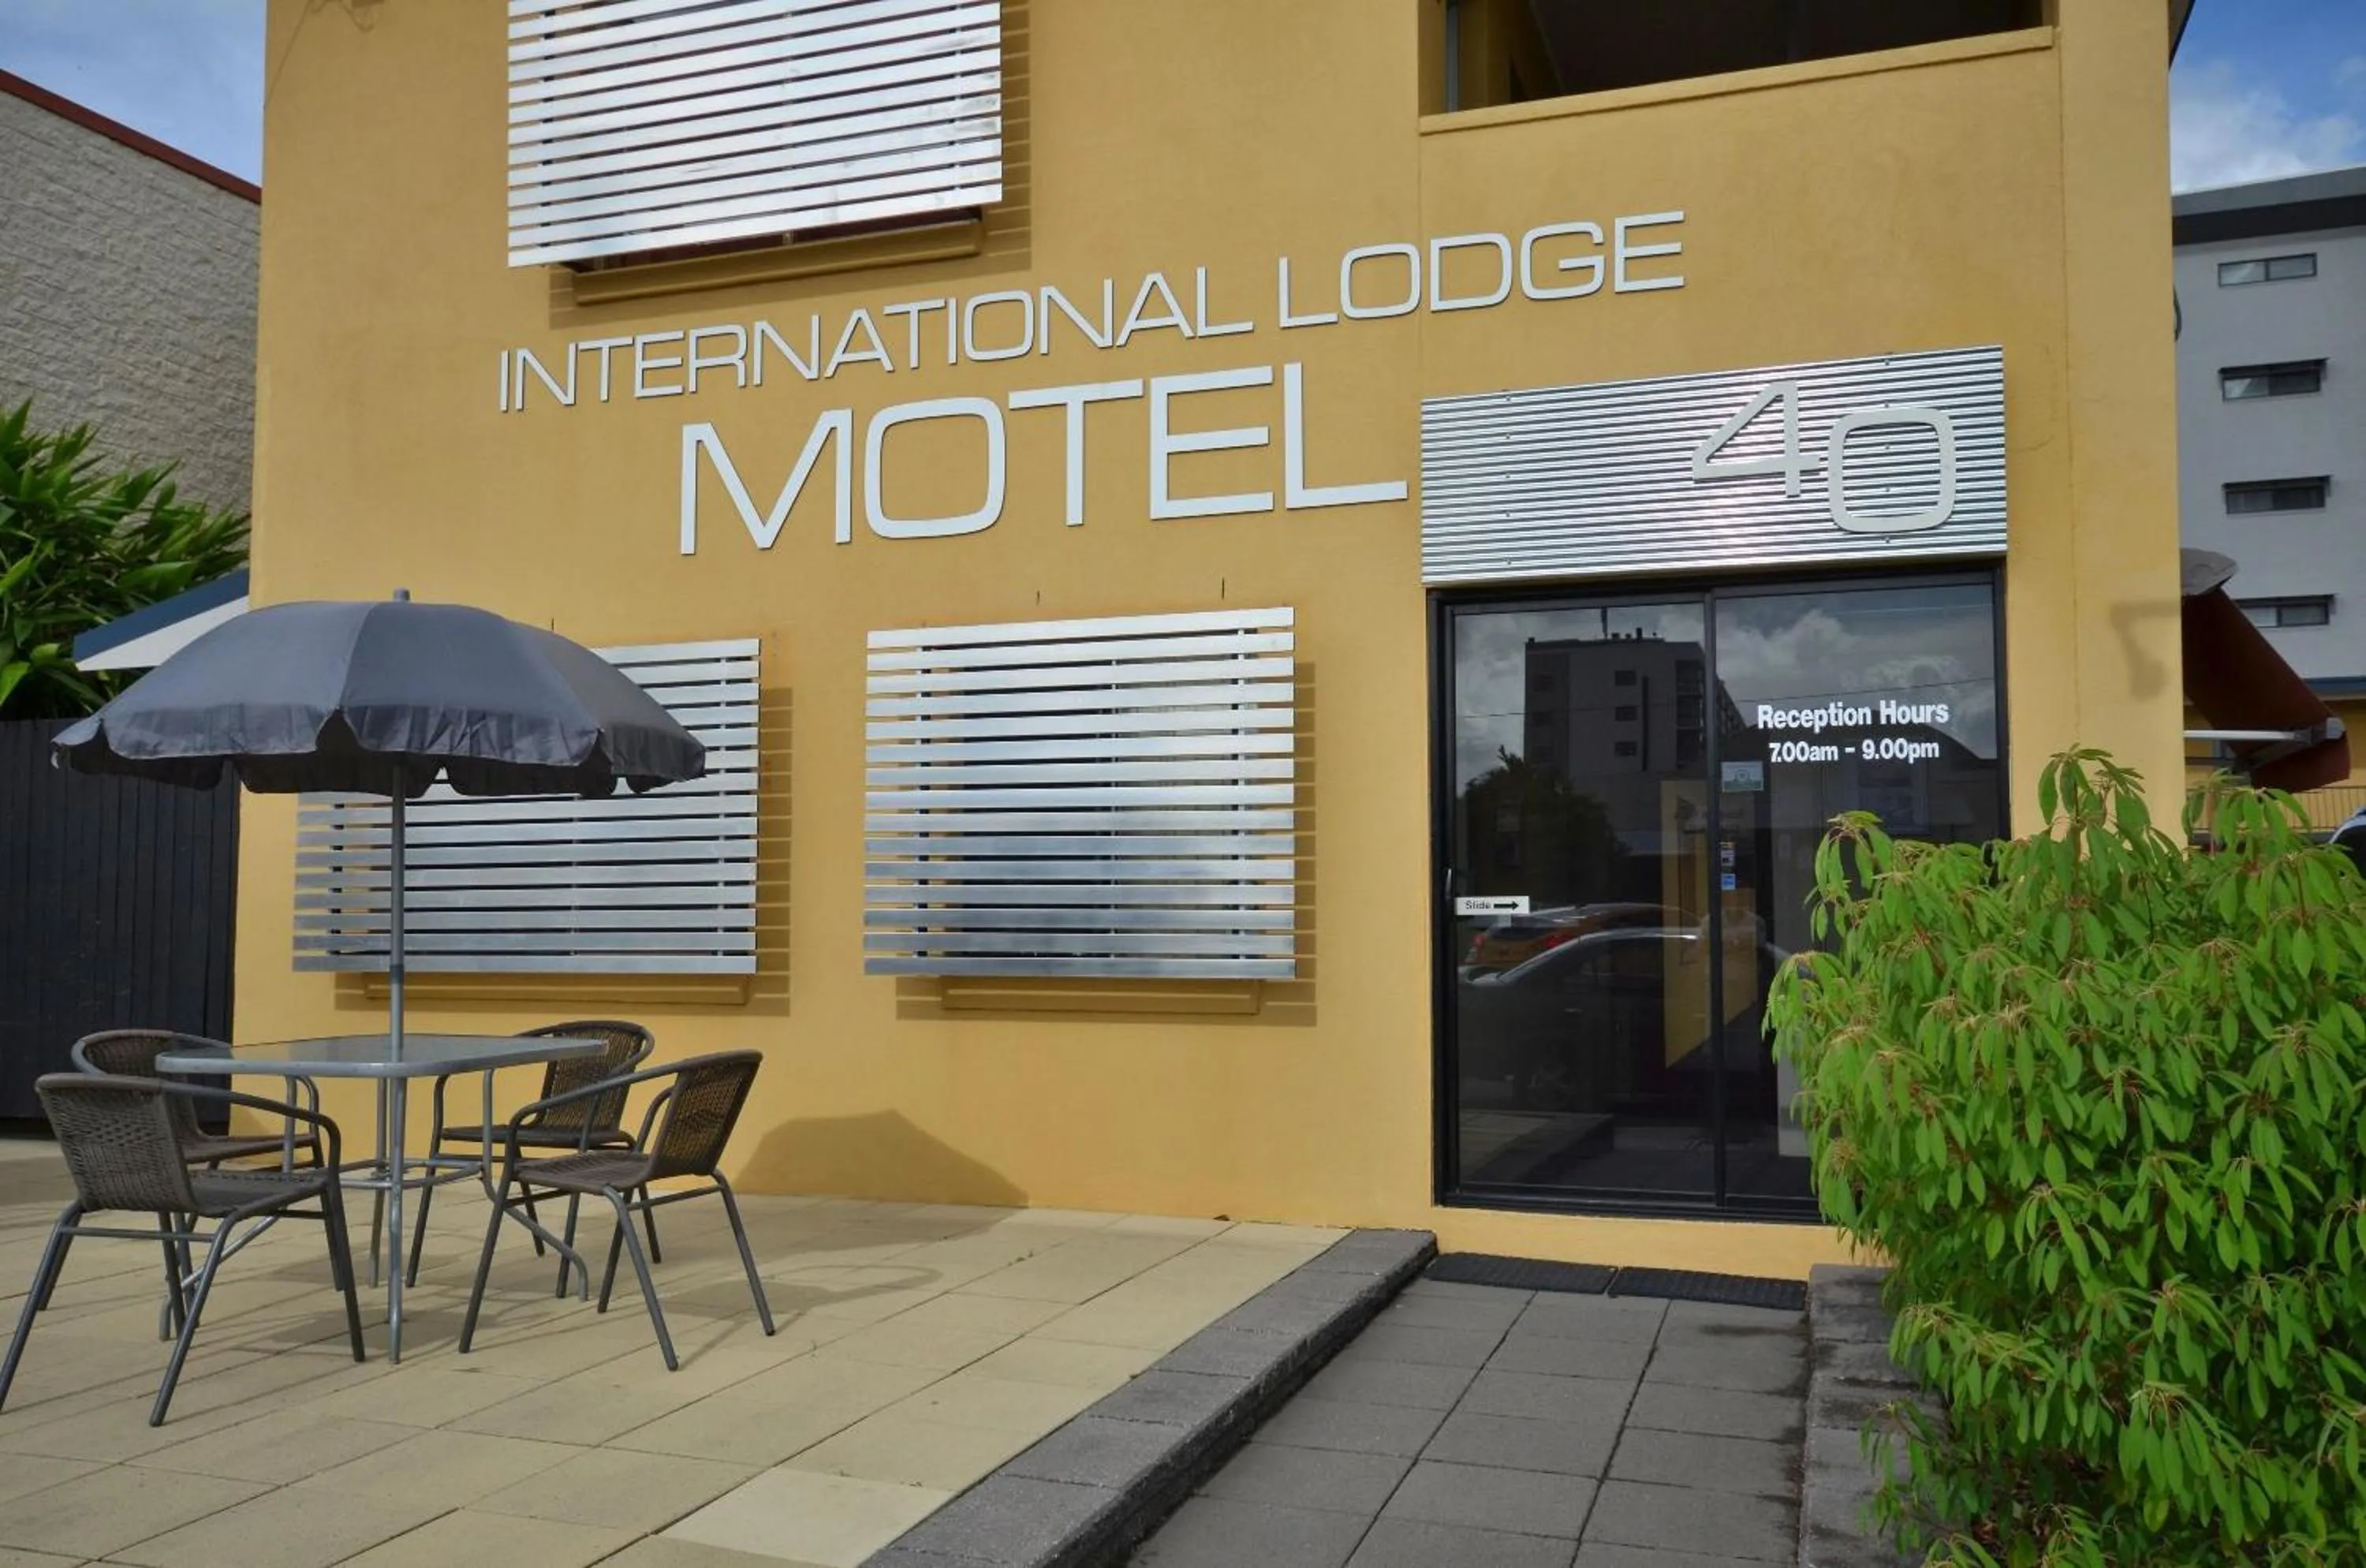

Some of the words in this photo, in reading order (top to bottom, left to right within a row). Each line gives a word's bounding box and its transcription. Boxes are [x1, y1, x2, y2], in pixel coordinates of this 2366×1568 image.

[499, 267, 1253, 412] INTERNATIONAL
[1278, 211, 1685, 329] LODGE
[680, 361, 1408, 554] MOTEL
[1692, 380, 1957, 533] 40
[1757, 702, 1872, 734] Reception
[1879, 700, 1950, 725] Hours
[1768, 741, 1838, 763] 7.00am
[1862, 737, 1939, 763] 9.00pm
[1465, 900, 1491, 909] Slide
